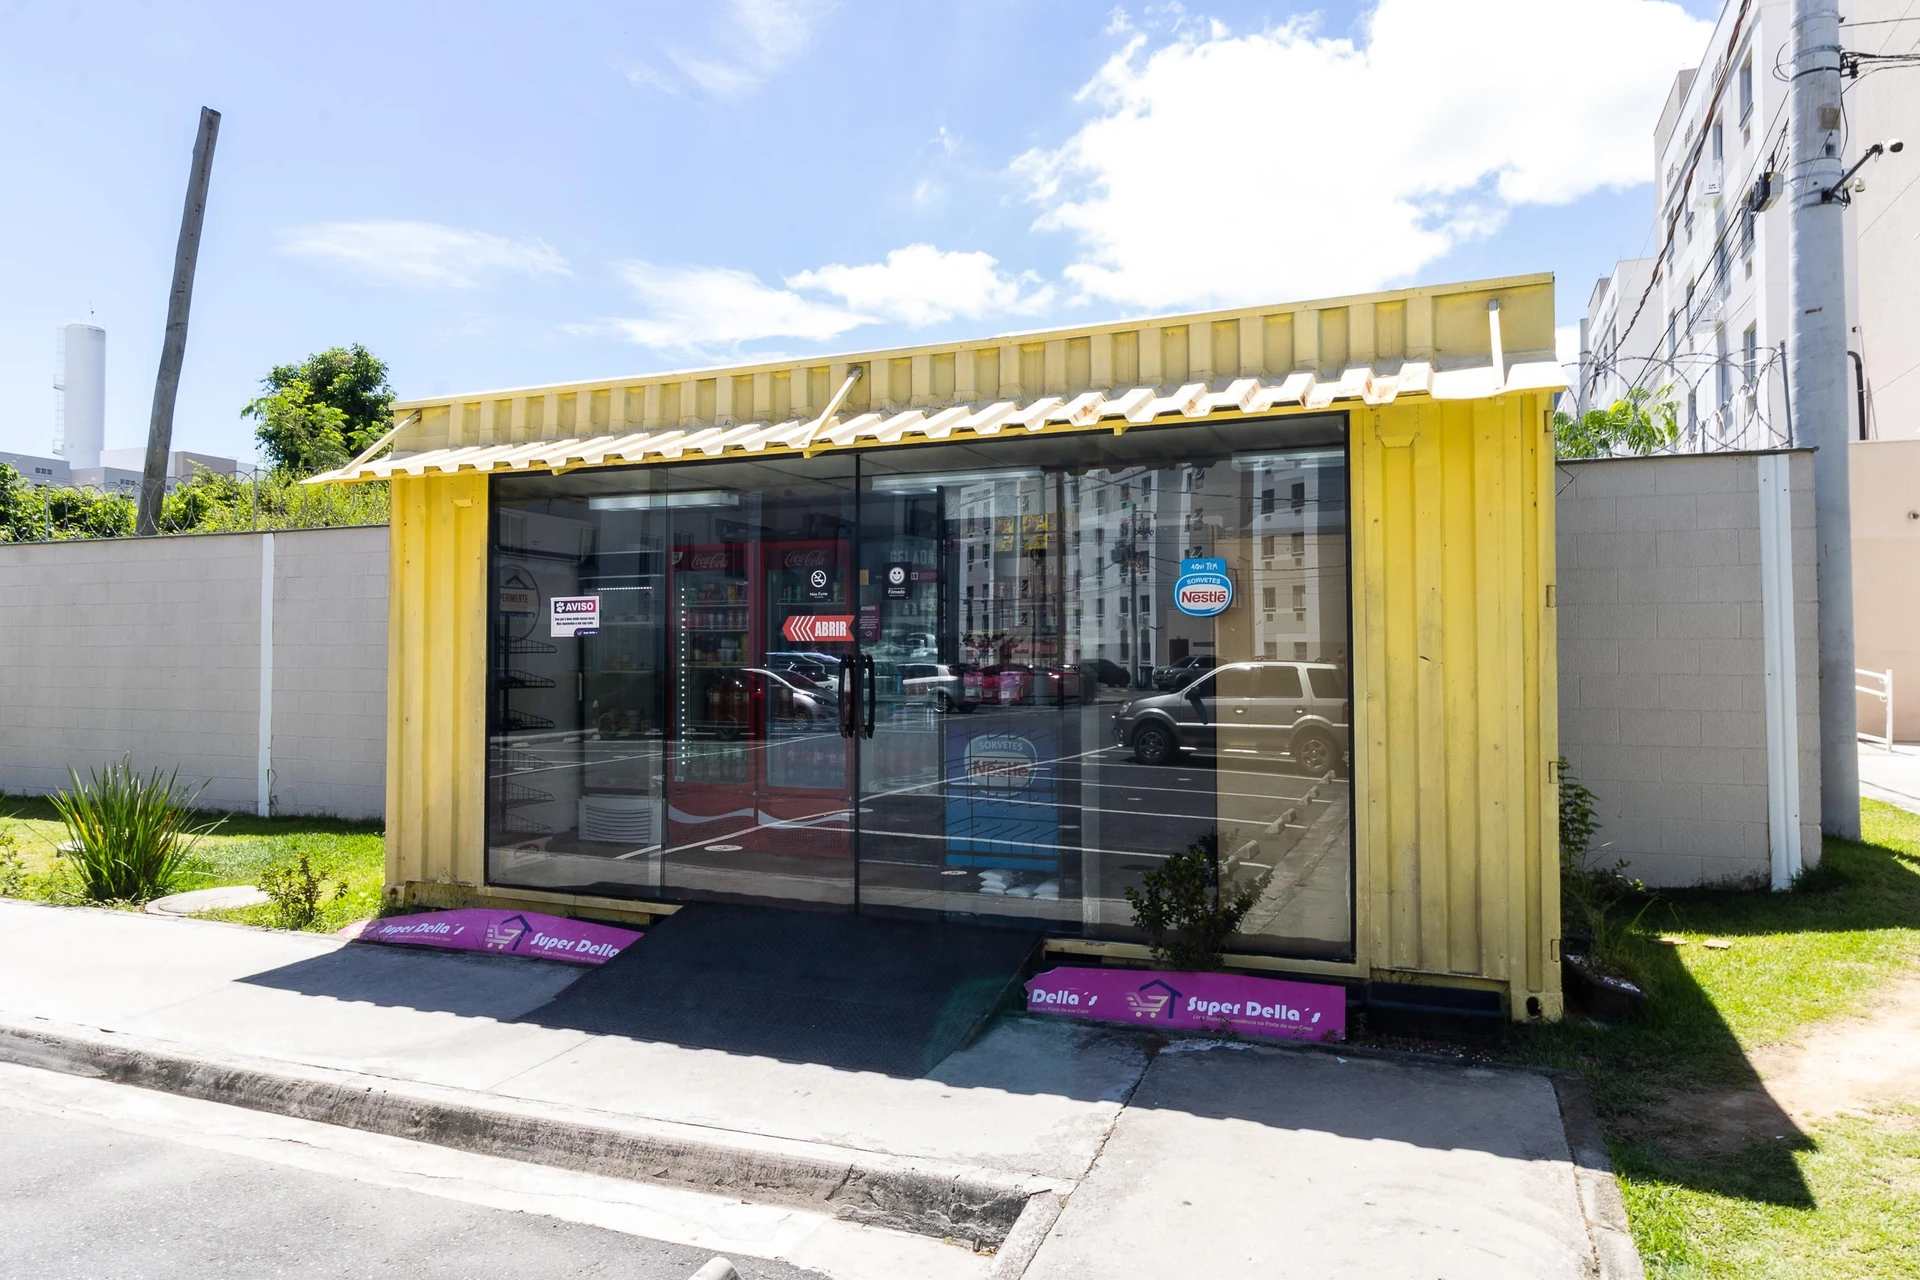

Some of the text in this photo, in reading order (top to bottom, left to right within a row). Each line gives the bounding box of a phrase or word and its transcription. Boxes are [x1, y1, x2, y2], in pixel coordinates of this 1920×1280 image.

[691, 553, 729, 568] Coca-Cola
[785, 549, 826, 567] Coca-Cola
[1205, 562, 1218, 570] TEM
[1186, 577, 1221, 585] SORVETES
[1181, 591, 1226, 603] Nestlé
[565, 602, 594, 611] AVISO
[815, 621, 847, 637] ABRIR
[979, 740, 1023, 751] SORVETES
[379, 924, 416, 935] Super
[530, 932, 575, 950] Super
[1187, 996, 1241, 1016] Super
